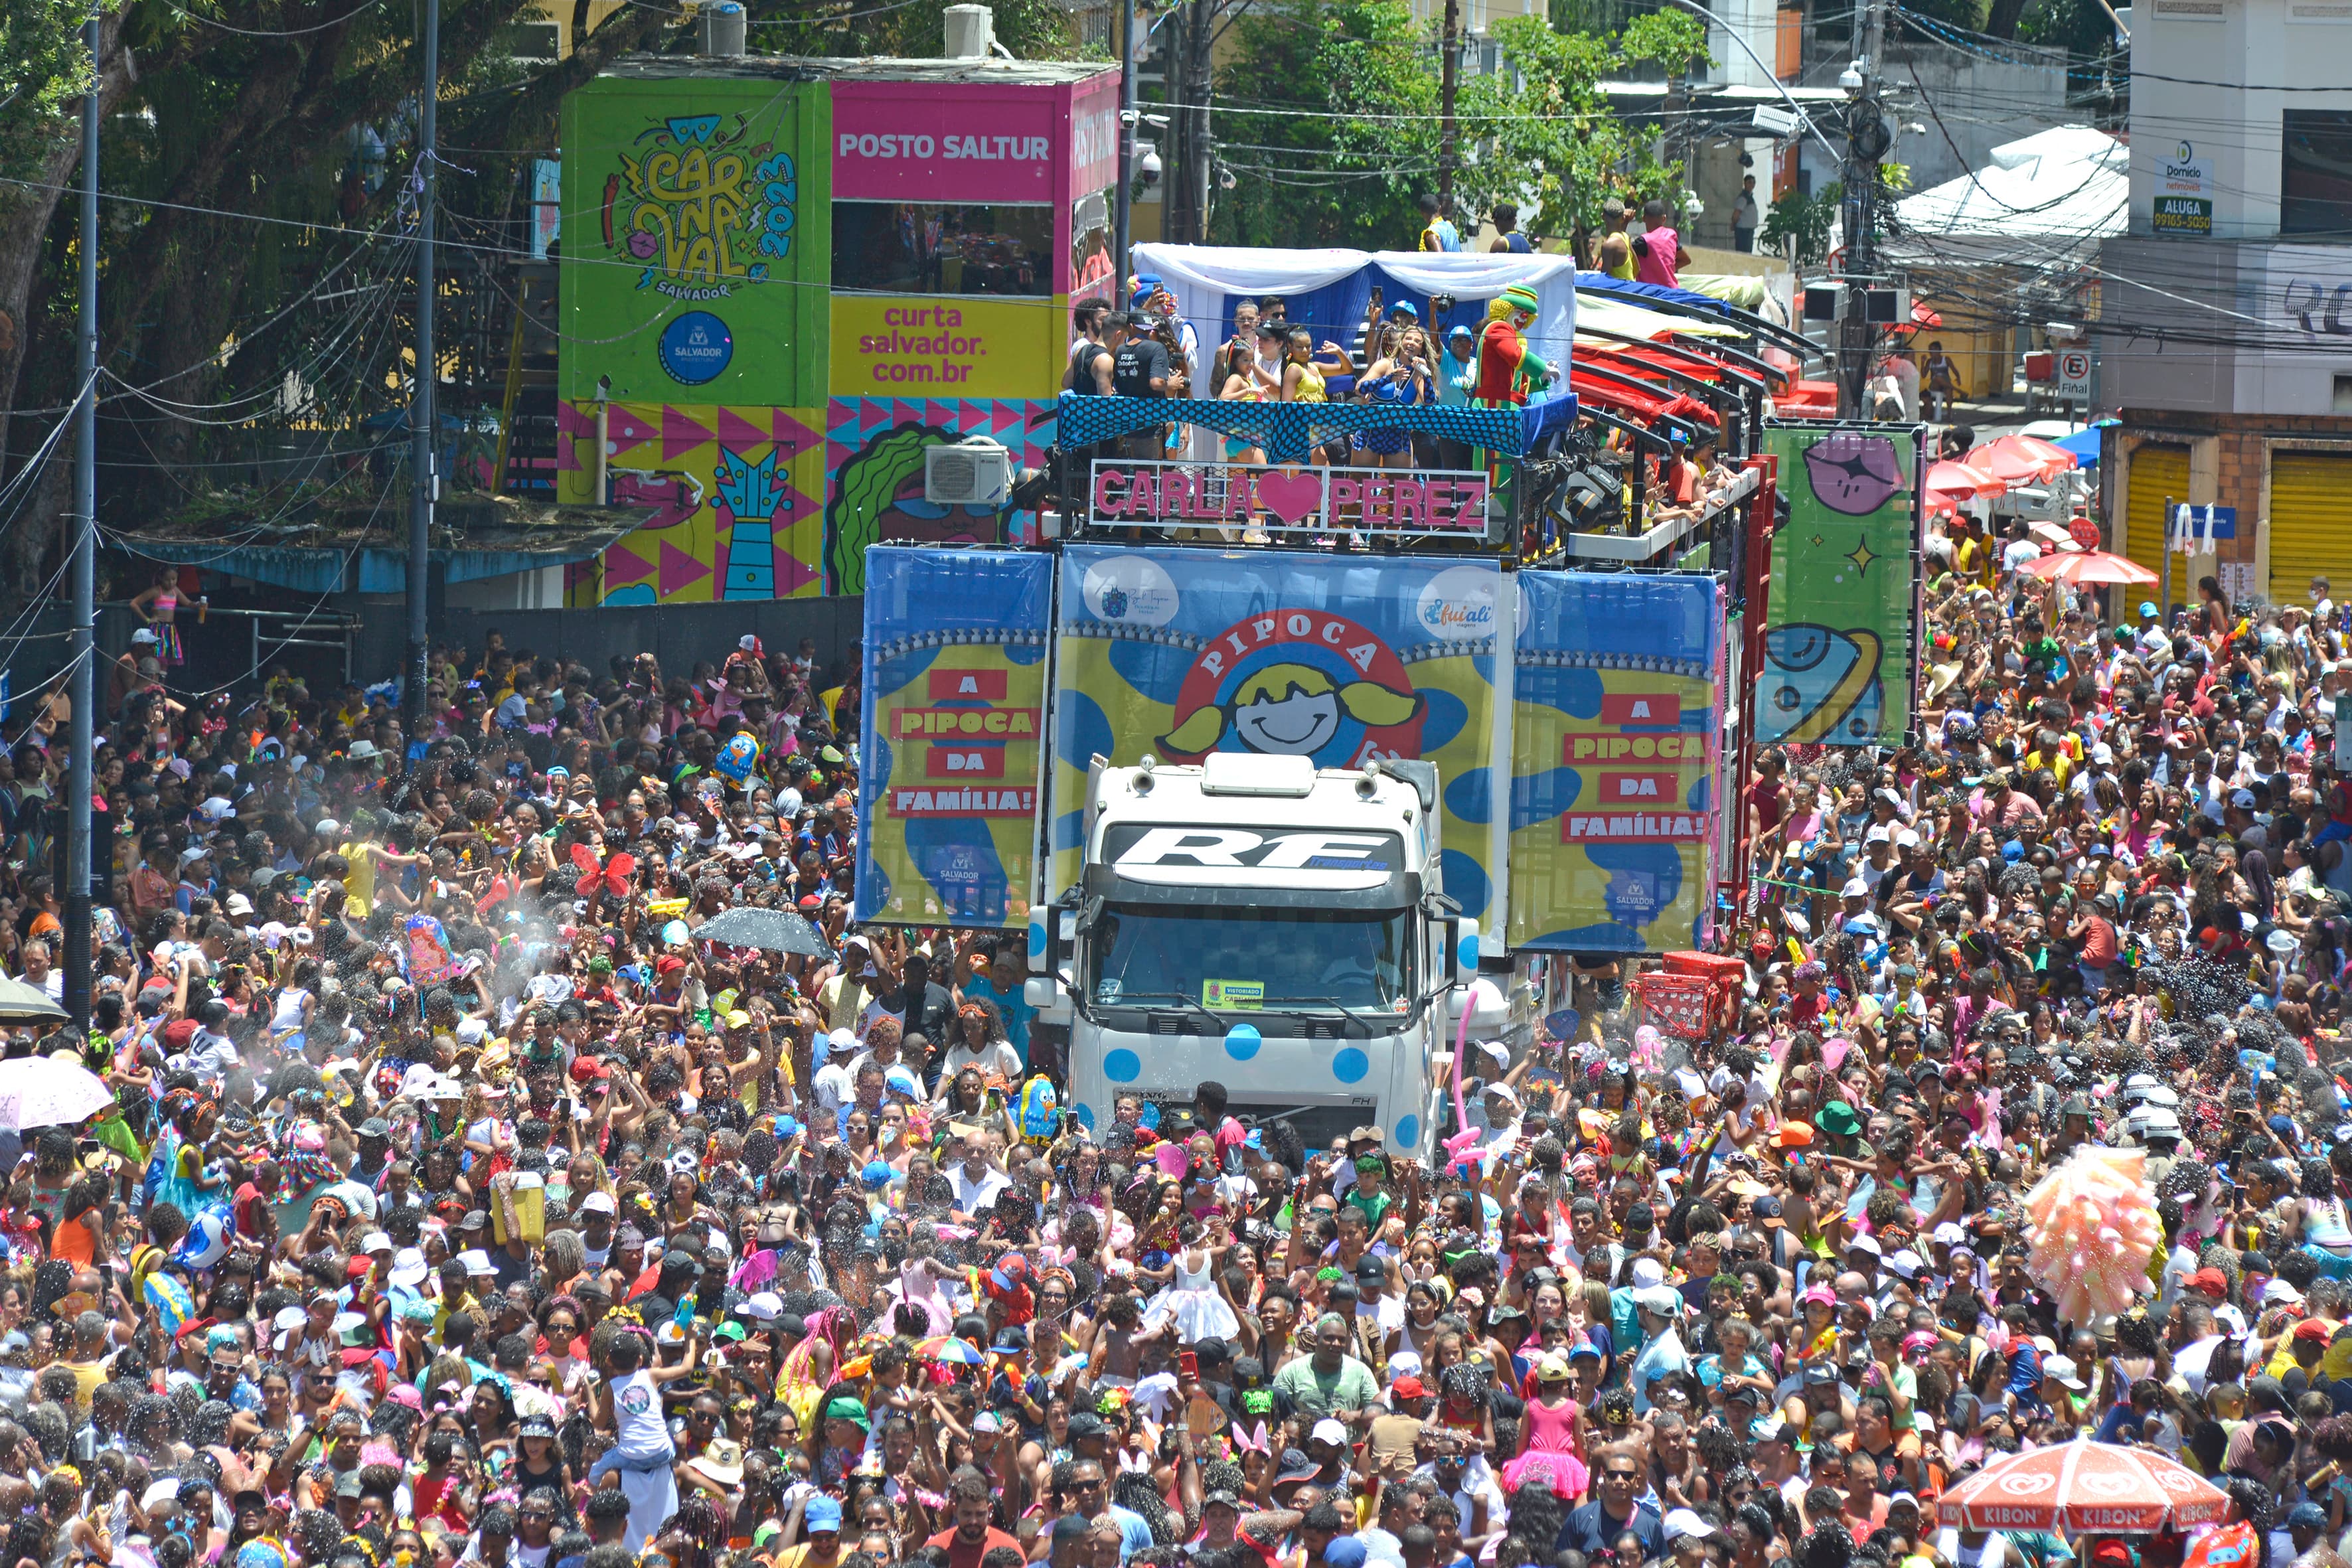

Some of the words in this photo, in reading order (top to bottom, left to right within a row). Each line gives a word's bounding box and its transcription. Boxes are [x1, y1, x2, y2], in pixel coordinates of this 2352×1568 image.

[840, 134, 934, 158] POSTO
[943, 135, 1050, 160] SALTUR
[2167, 165, 2201, 178] Domício
[753, 152, 797, 260] 2023
[2165, 200, 2201, 215] ALUGA
[2155, 213, 2211, 229] 99165-5050
[656, 281, 731, 300] SALVADOR
[884, 305, 962, 327] curta
[859, 329, 986, 355] salvador.
[675, 347, 722, 356] SALVADOR
[872, 358, 973, 382] com.br
[2062, 383, 2087, 394] Final
[1095, 469, 1255, 519] CARLA
[1329, 477, 1484, 527] PEREZ
[1200, 615, 1377, 678] PIPOCA
[958, 676, 979, 693] A
[1630, 701, 1650, 718] A
[900, 712, 1034, 734] PIPOCA
[1573, 737, 1705, 759] PIPOCA
[947, 753, 985, 770] DA
[1620, 779, 1658, 796] DA
[897, 785, 1032, 811] FAMÍLIA!
[1569, 811, 1705, 837] FAMÍLIA!
[1114, 828, 1391, 868] RF
[1309, 856, 1388, 871] Transportes
[940, 870, 979, 880] SALVADOR
[1616, 897, 1655, 906] SALVADOR
[1984, 1509, 2037, 1524] KIBON
[2083, 1509, 2140, 1524] KIBON
